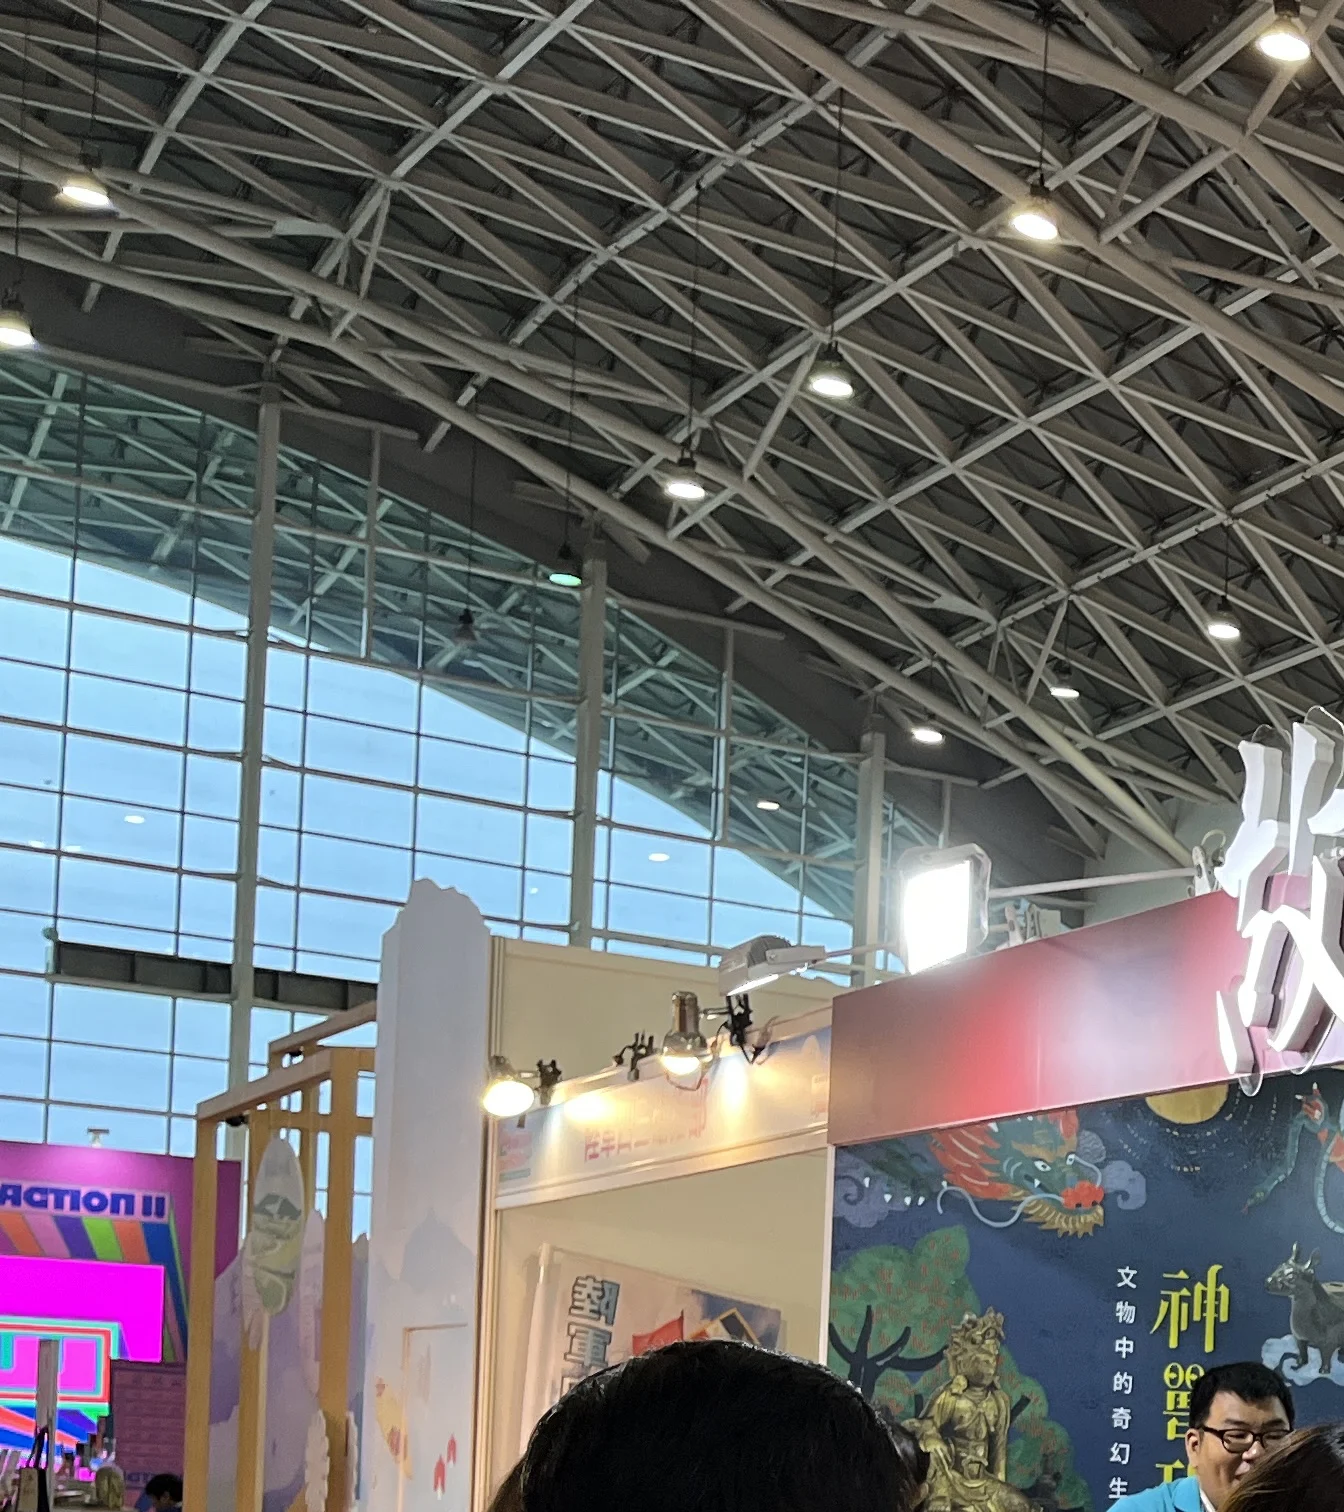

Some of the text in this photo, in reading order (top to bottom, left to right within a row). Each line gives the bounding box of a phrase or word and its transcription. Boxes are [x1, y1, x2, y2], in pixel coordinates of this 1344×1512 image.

[0, 1183, 136, 1217] ACTION
[1108, 1265, 1138, 1500] 文物中的奇幻生
